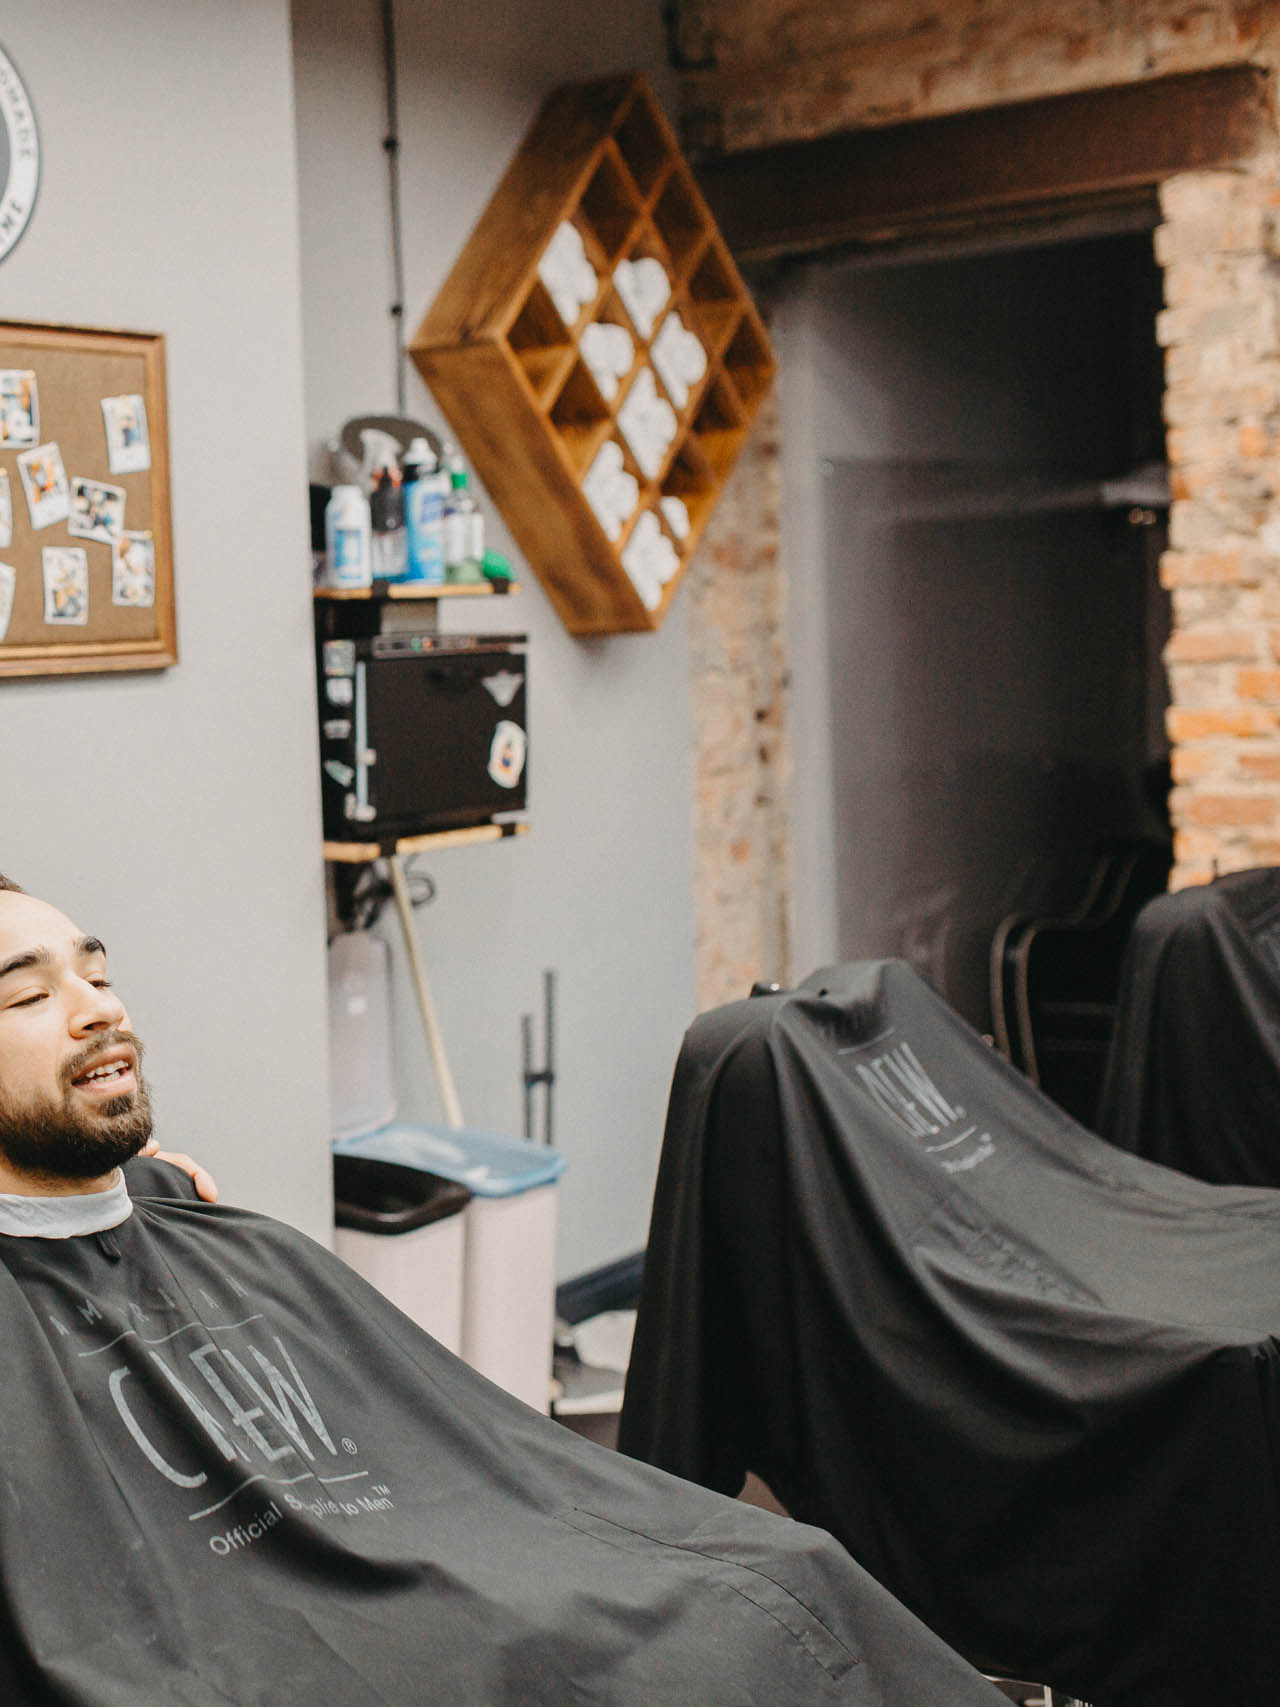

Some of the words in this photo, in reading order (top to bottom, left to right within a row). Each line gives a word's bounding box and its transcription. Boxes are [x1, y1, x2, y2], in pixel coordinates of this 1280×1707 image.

[49, 1276, 248, 1336] AMRIAN
[209, 1501, 284, 1556] Official
[339, 1502, 360, 1516] to
